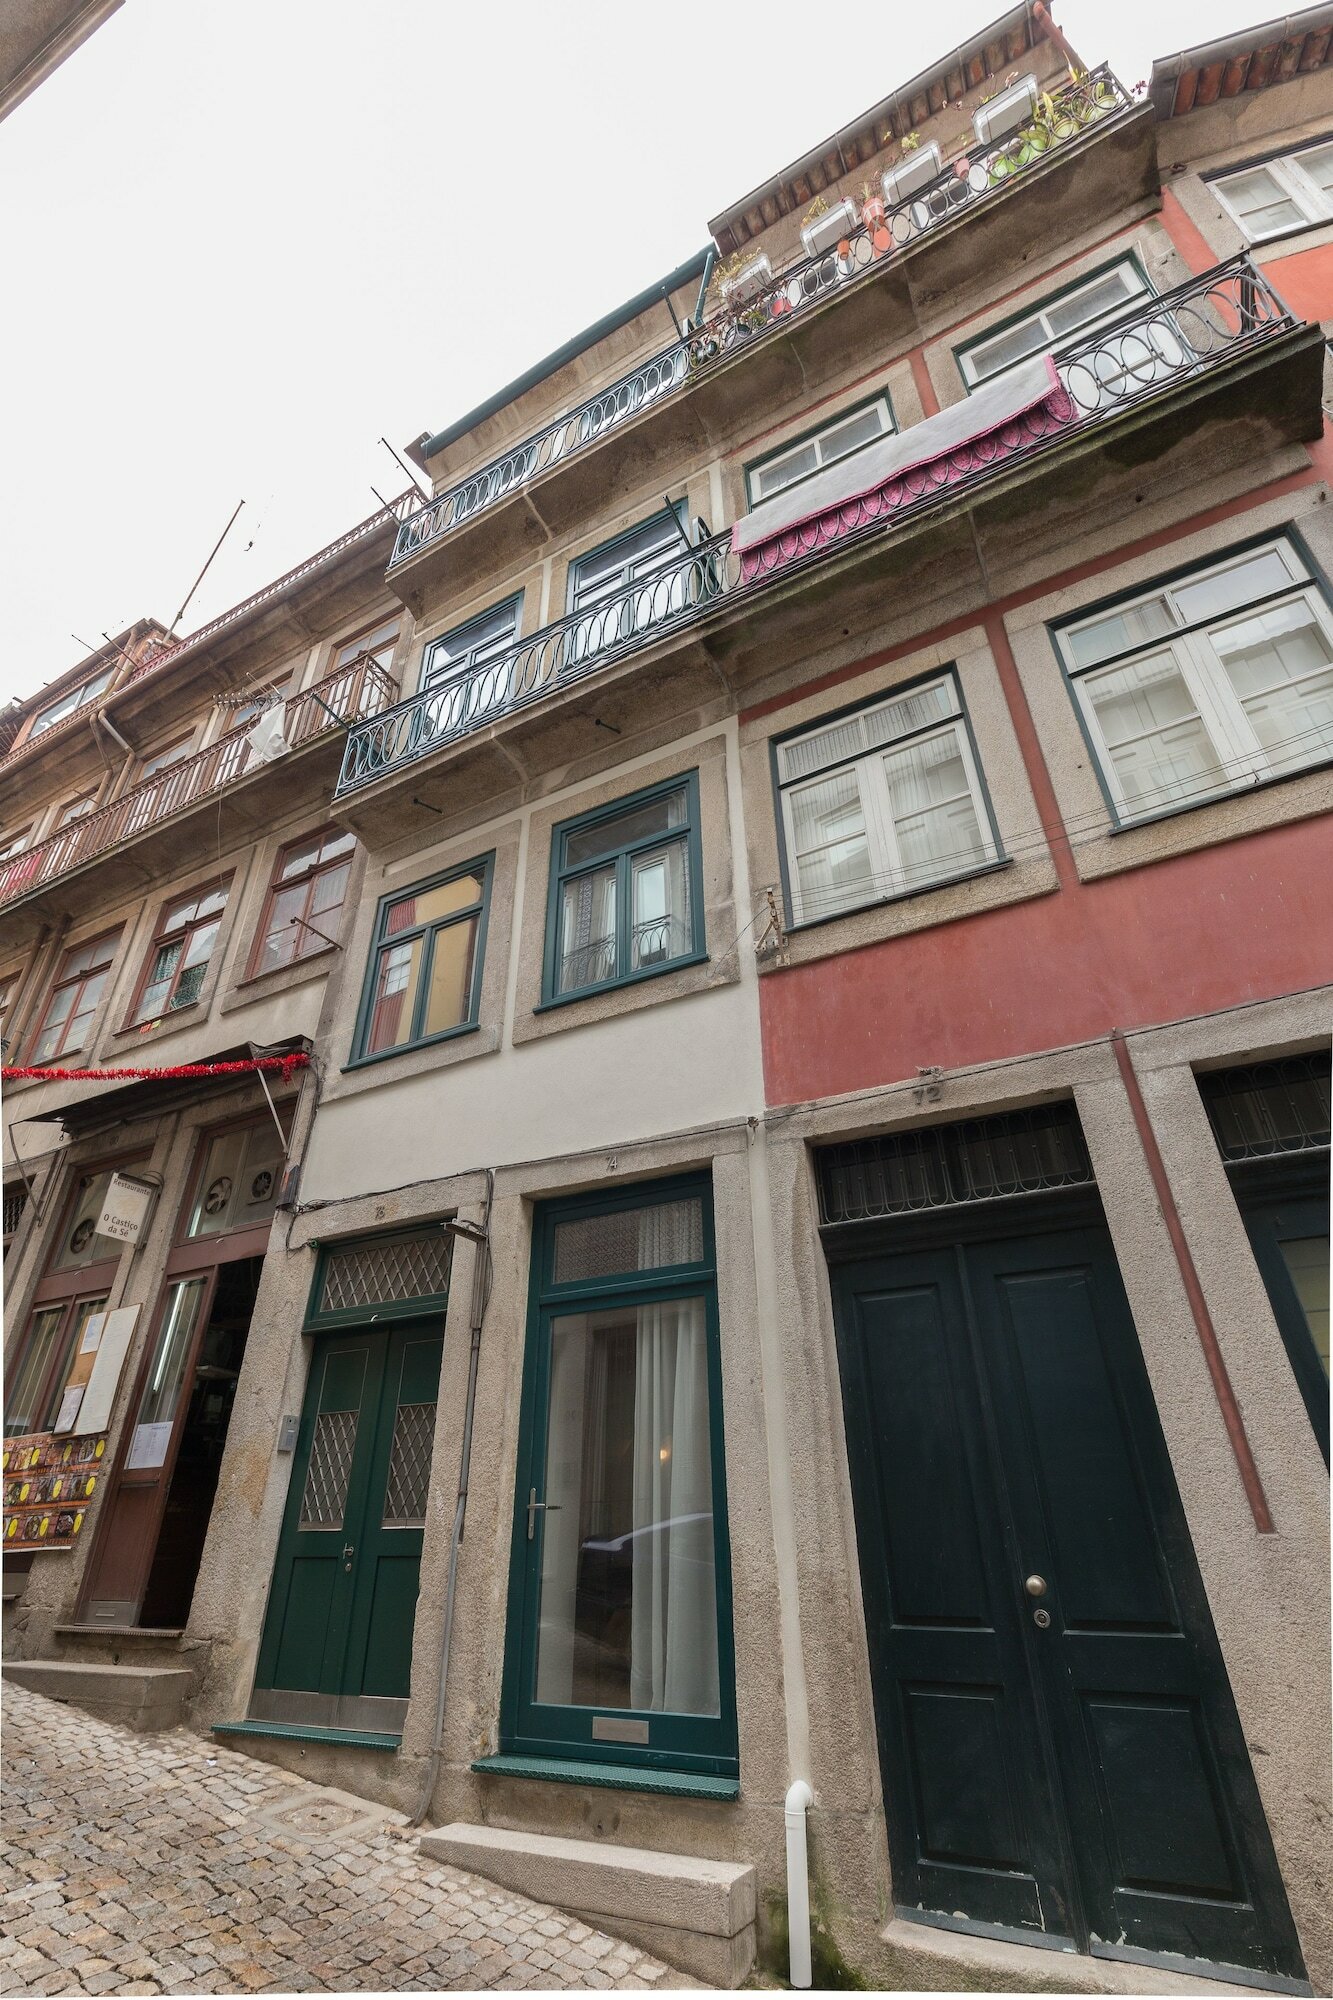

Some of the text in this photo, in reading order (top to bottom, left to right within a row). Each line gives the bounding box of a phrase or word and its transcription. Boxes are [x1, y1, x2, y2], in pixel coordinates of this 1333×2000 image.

[912, 1085, 942, 1105] 72
[605, 1156, 618, 1170] 74
[113, 1178, 151, 1196] Restaurante
[104, 1213, 138, 1231] O Castiço
[108, 1225, 129, 1237] da Sé
